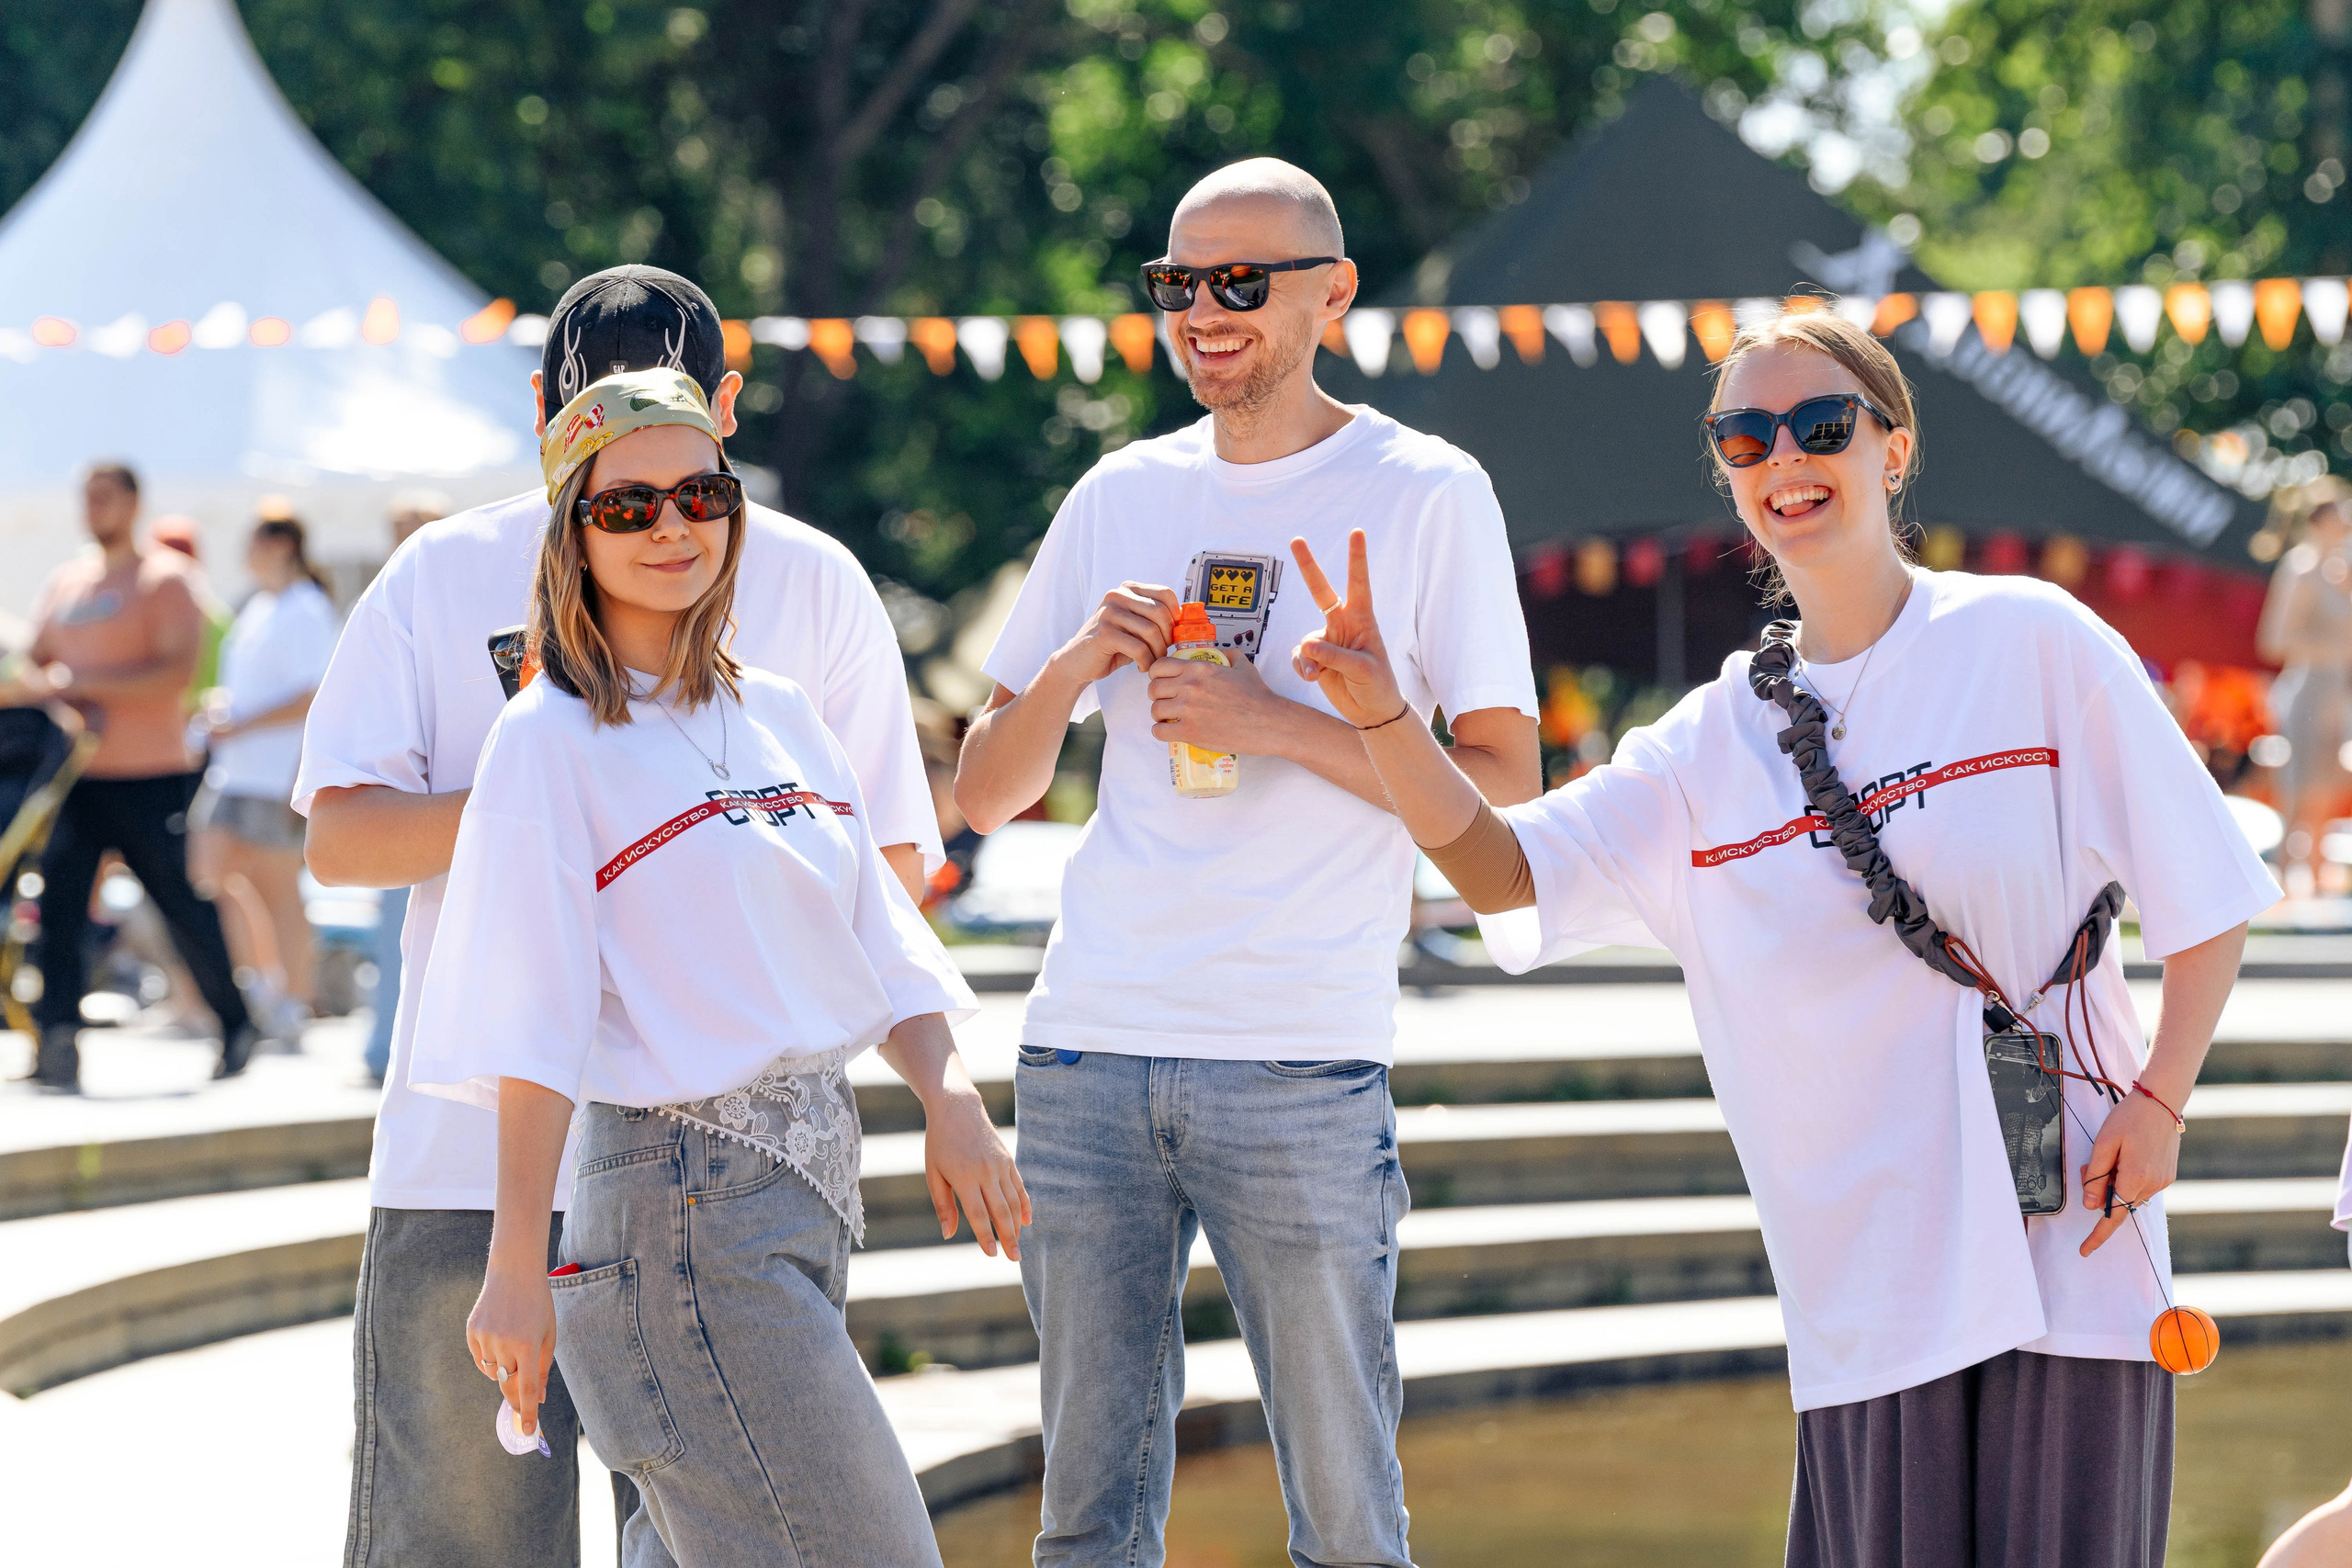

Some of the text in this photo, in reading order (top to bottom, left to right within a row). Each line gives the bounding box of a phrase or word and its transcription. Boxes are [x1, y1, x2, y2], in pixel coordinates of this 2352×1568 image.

[613, 365, 626, 374] GAP
[1208, 593, 1251, 605] LIFE
[1210, 583, 1238, 592] GET
[1857, 779, 1927, 815] СКУССТВО
[1942, 762, 1977, 778] КАК
[1804, 761, 1932, 849] СОРТ
[603, 858, 626, 881] КАК
[625, 807, 709, 863] ИСКУССТВО
[719, 800, 741, 809] КАК
